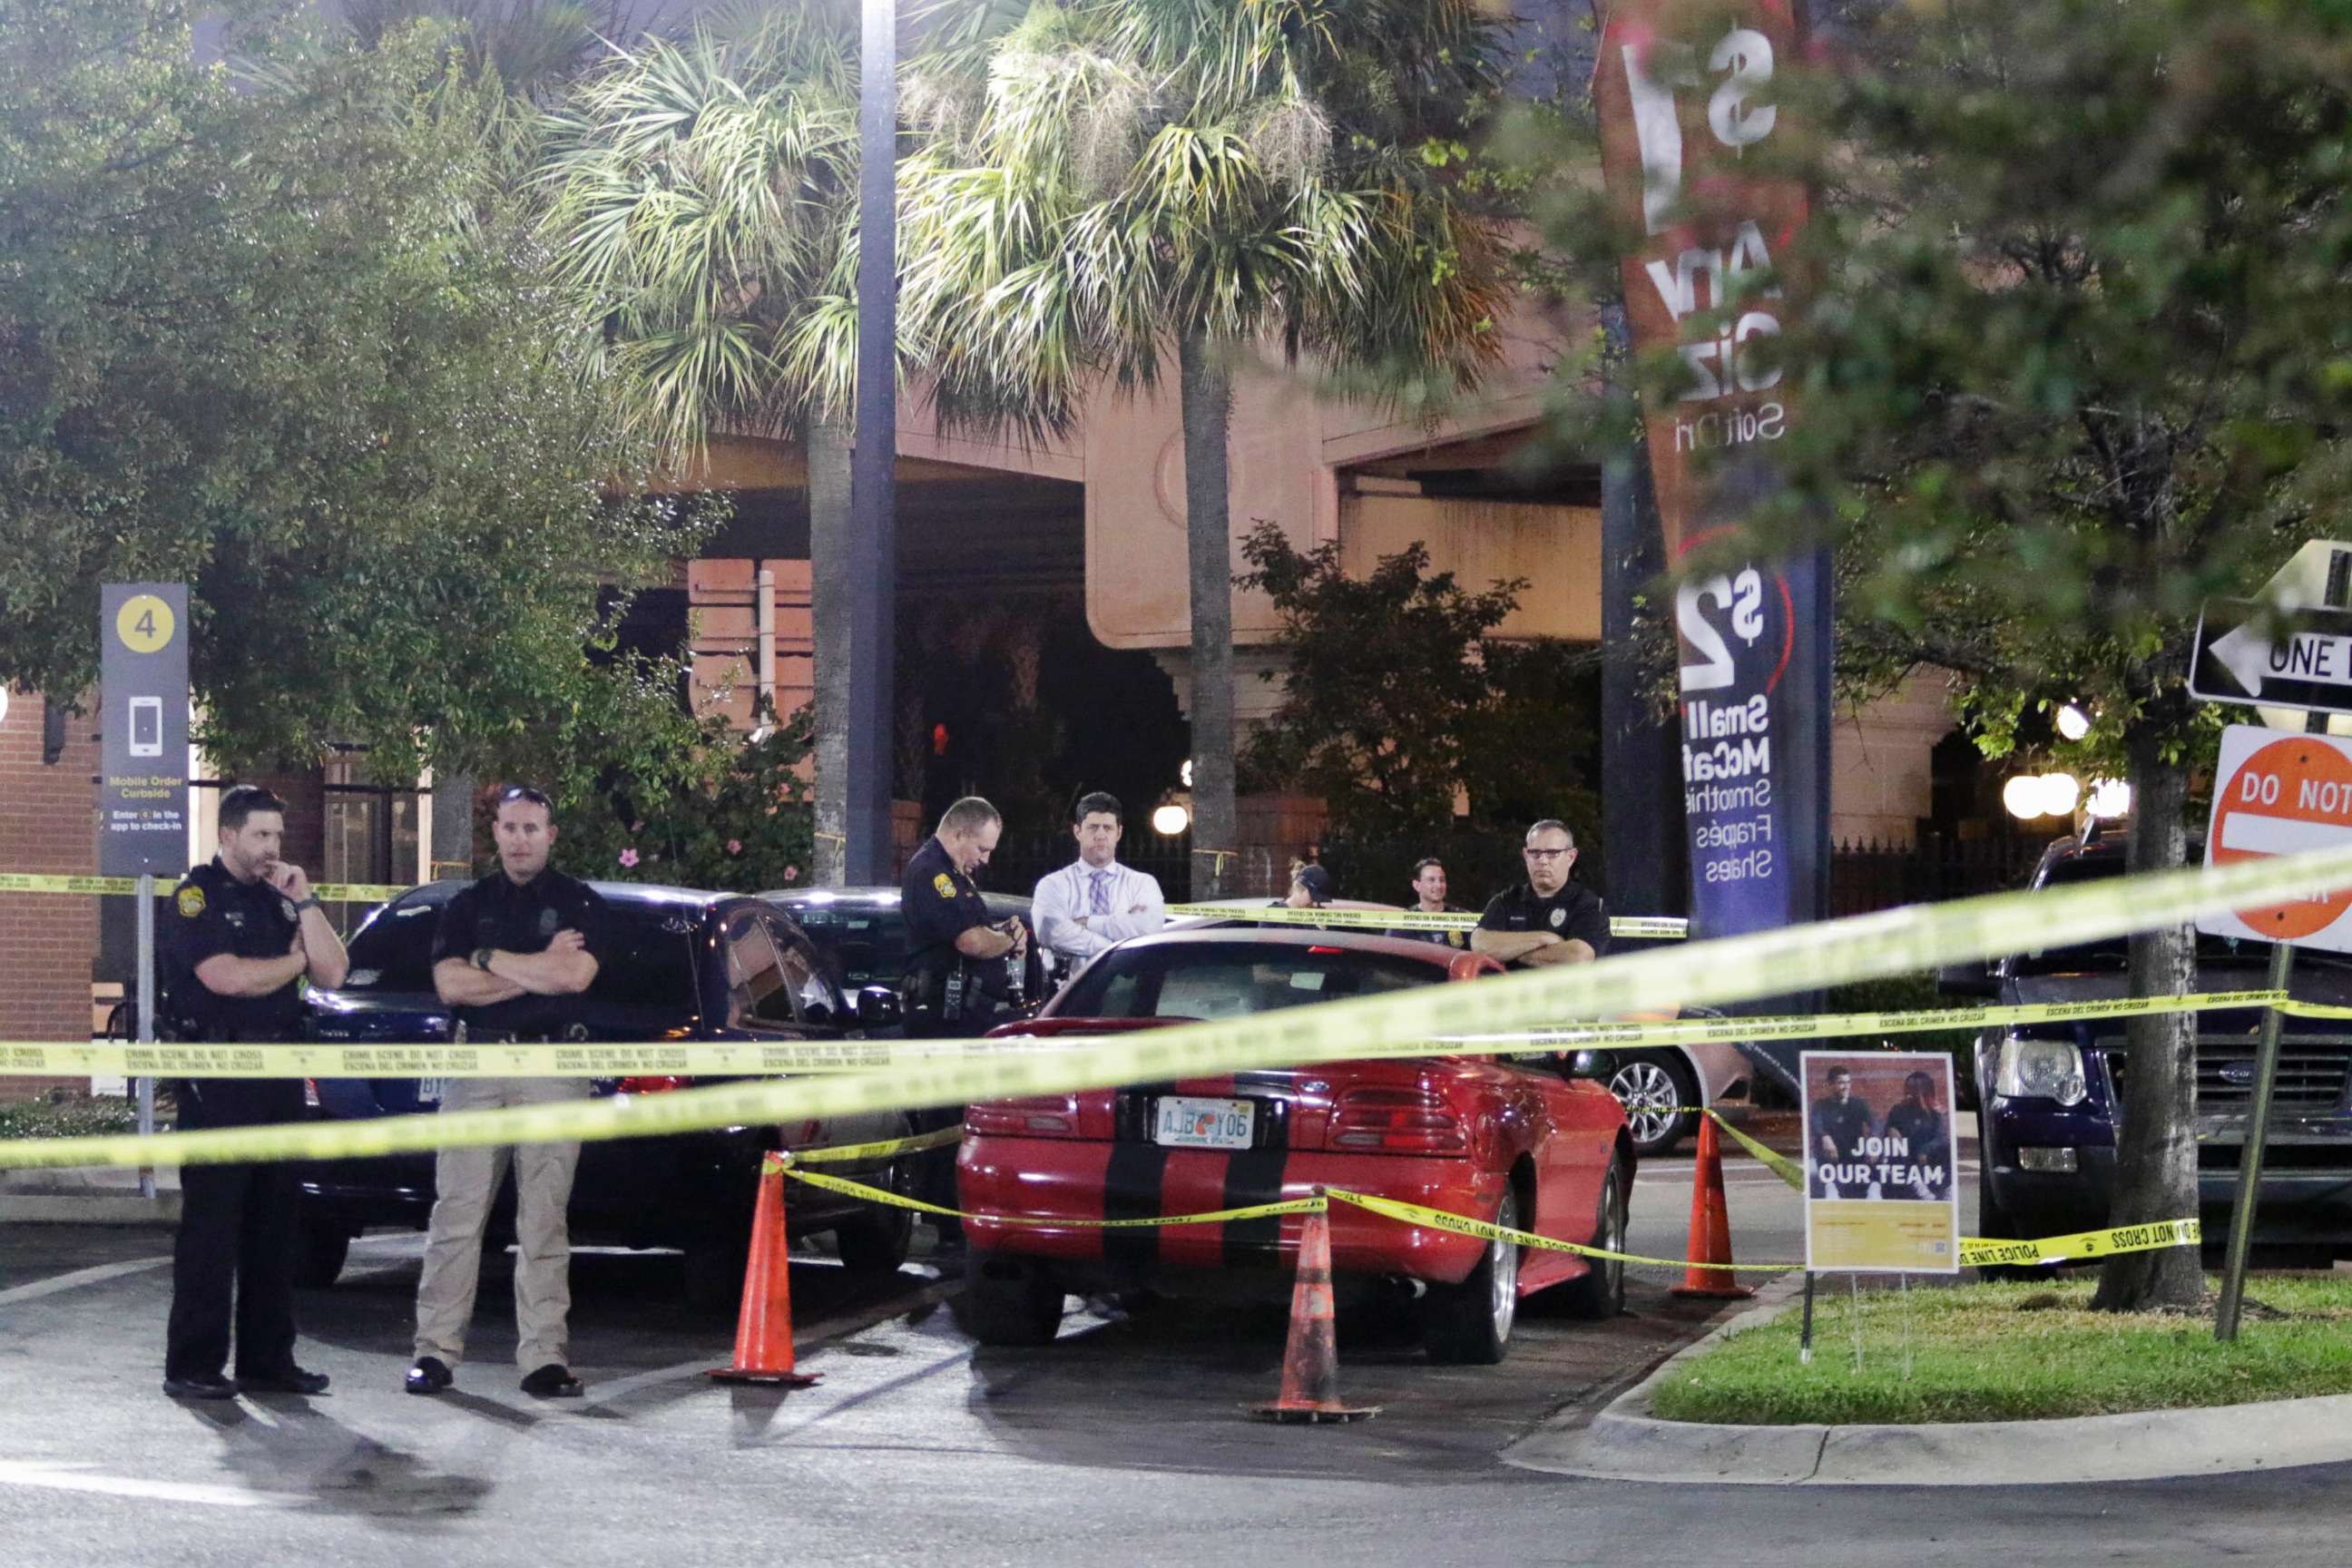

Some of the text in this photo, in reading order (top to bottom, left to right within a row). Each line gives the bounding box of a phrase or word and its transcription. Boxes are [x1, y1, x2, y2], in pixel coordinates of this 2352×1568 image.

[133, 609, 158, 639] 4
[110, 776, 182, 787] Mobile Order
[121, 789, 171, 799] Curbside
[2241, 771, 2352, 814] DO NOT
[113, 809, 139, 819] Enter
[164, 809, 180, 818] the
[111, 821, 181, 831] app to check-in
[1851, 1137, 1909, 1157] JOIN
[1818, 1163, 1943, 1185] OUR TEAM
[2112, 1228, 2150, 1249] CROSS
[2152, 1224, 2175, 1243] NOT
[1970, 1250, 1997, 1263] LINE
[1999, 1243, 2040, 1260] POLICE
